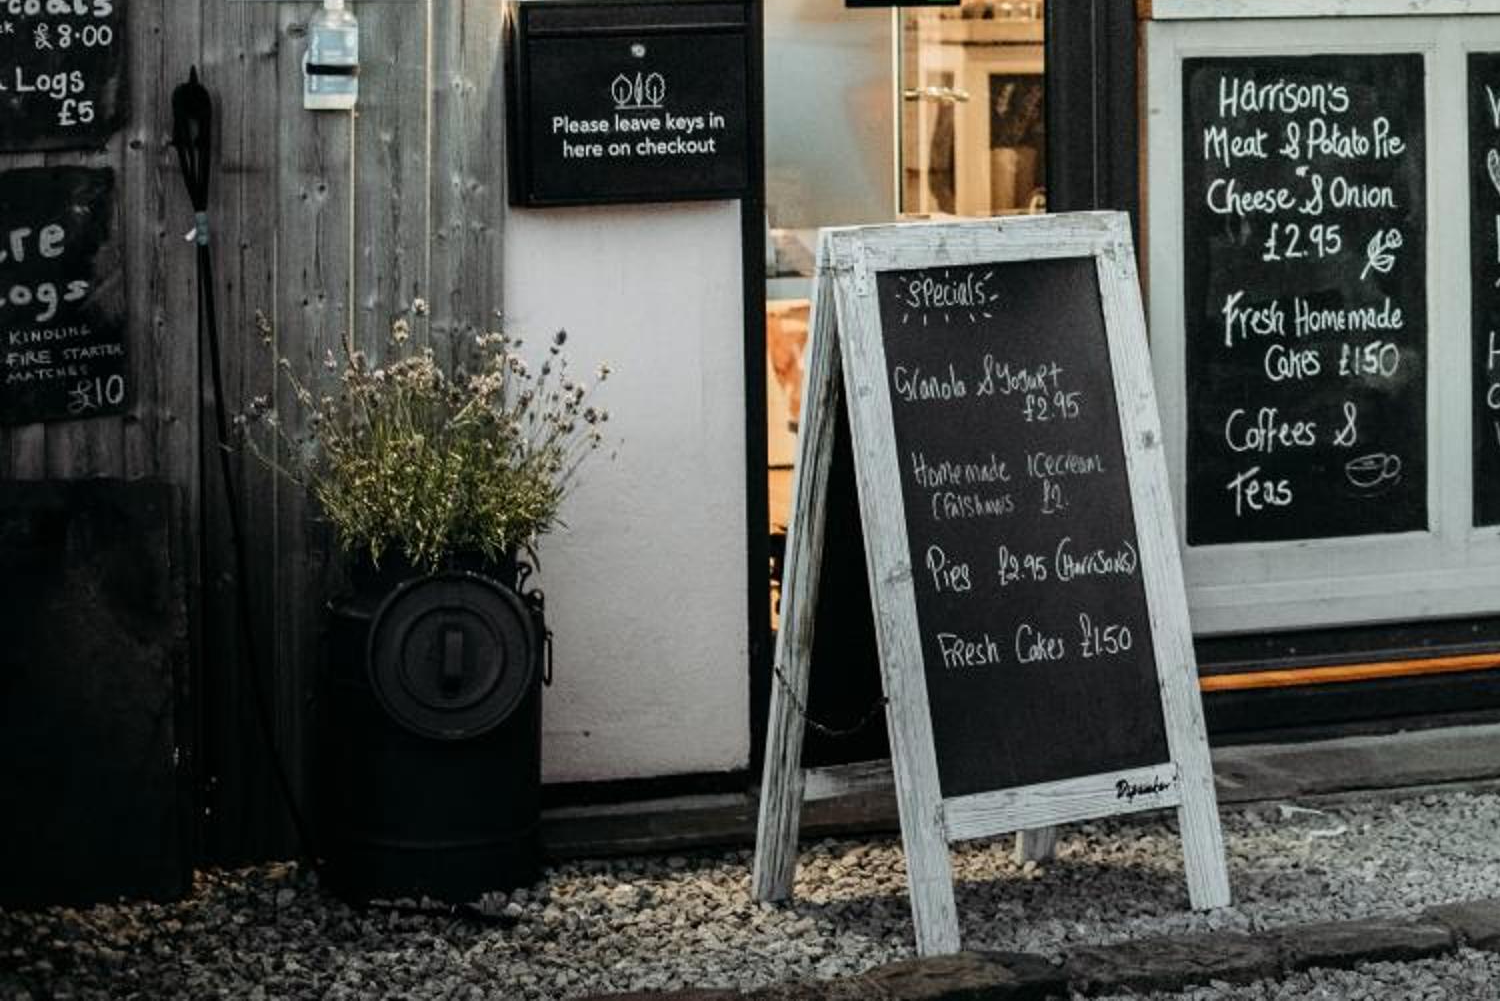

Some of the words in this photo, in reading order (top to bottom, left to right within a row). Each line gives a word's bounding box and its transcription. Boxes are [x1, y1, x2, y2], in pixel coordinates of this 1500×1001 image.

[15, 65, 86, 100] Logs
[1219, 76, 1350, 118] Harrison's
[57, 98, 96, 127] £5
[552, 115, 609, 134] Please
[614, 114, 661, 132] leave
[665, 112, 705, 134] keys
[708, 111, 725, 130] in
[562, 139, 603, 159] here
[608, 142, 631, 156] on
[635, 137, 717, 156] checkout
[1203, 124, 1268, 168] Meat
[1280, 120, 1300, 160] &
[1307, 117, 1369, 160] Potato
[1373, 116, 1406, 160] Pie
[1206, 177, 1297, 216] Cheese
[1299, 173, 1323, 216] &
[1329, 176, 1398, 209] Onion
[1262, 221, 1342, 262] £2.95
[1222, 289, 1285, 347] Fresh
[1264, 343, 1320, 381] Cakes
[65, 374, 125, 416] £10
[1023, 390, 1084, 423] £2.95
[1226, 406, 1317, 453] Coffees
[1333, 401, 1357, 447] &
[1227, 465, 1293, 517] Teas
[926, 544, 973, 592] Pies
[999, 544, 1047, 587] £2.95
[1016, 623, 1066, 664] Cakes
